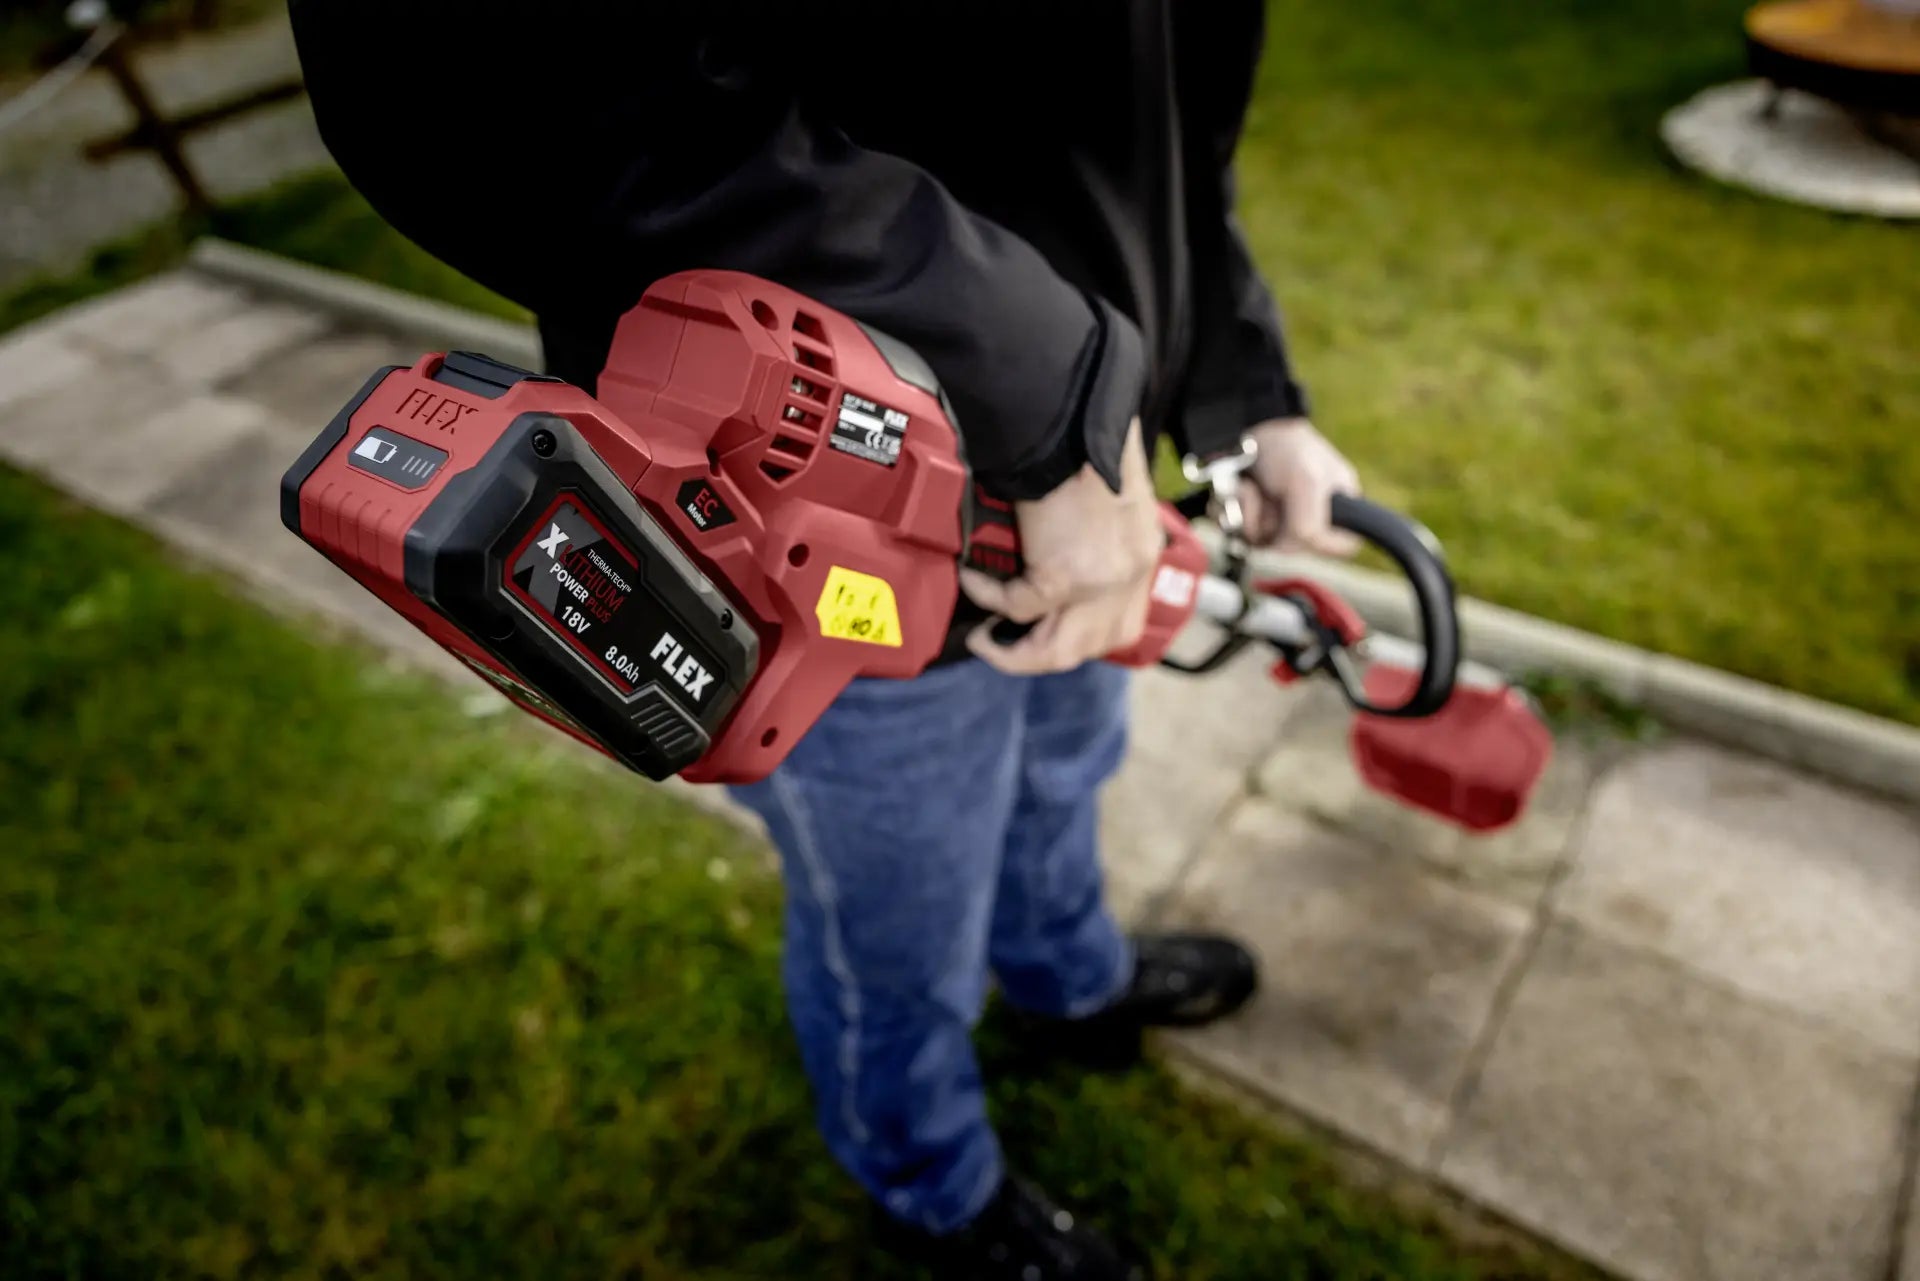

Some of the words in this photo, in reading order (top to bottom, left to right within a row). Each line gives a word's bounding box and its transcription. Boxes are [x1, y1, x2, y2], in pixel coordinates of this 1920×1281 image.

[395, 388, 480, 435] FLEX
[687, 503, 707, 527] Motor
[694, 487, 718, 518] EC
[549, 563, 589, 603] POWER
[561, 605, 592, 634] 18V
[605, 645, 640, 684] 8.0Ah
[650, 632, 714, 701] FLEX
